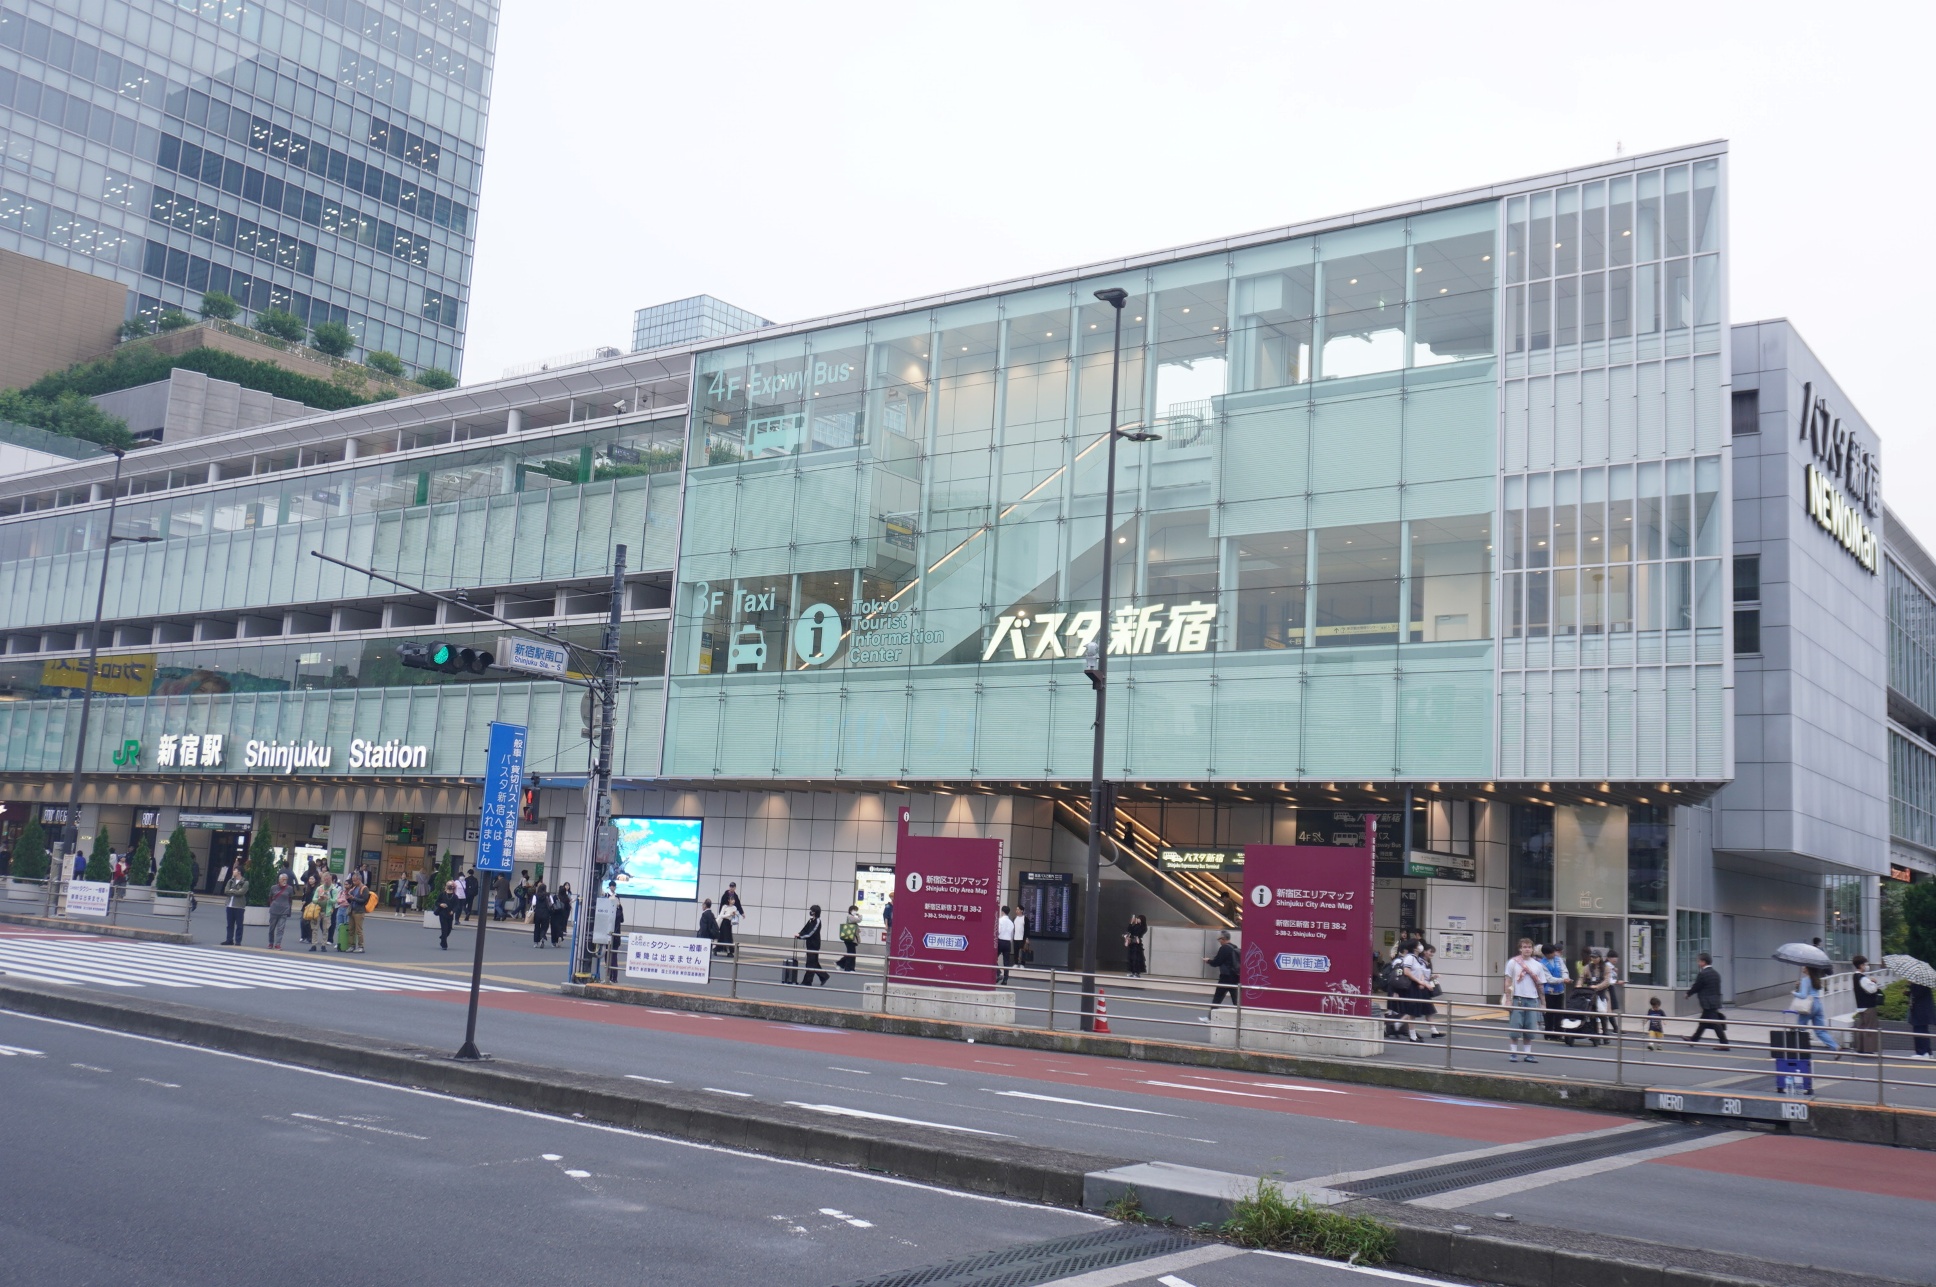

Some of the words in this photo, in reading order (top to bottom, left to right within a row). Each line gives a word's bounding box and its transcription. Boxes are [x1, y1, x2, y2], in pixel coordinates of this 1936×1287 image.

[708, 369, 740, 402] 4F
[750, 370, 808, 399] Expwy
[814, 362, 850, 386] Bus
[1800, 381, 1879, 518] バスタ新宿
[696, 581, 724, 615] 3F
[733, 587, 775, 612] Taxi
[853, 598, 899, 615] Tokyo
[852, 614, 907, 631] Tourist
[982, 600, 1218, 661] バスタ新宿
[851, 628, 944, 647] Information
[514, 643, 564, 664] 新宿駅南口
[514, 656, 538, 666] Shinjuku
[850, 648, 902, 664] Center
[112, 740, 141, 766] JR
[157, 734, 222, 766] 新宿駅
[244, 740, 332, 774] Shinjuku
[350, 738, 427, 768] Station
[494, 754, 512, 840] バスタ新宿へは
[502, 732, 524, 867] 一般車・貸切バス・大型貨物車は
[480, 803, 494, 865] 入れません
[1299, 831, 1311, 841] 4F
[1184, 853, 1225, 862] バスタ新宿
[926, 875, 989, 886] 新宿区エリアマップ
[926, 885, 948, 893] Shinjuku
[949, 886, 960, 894] City
[1276, 888, 1354, 901] 新宿区エリアマップ
[1276, 899, 1303, 908] Shinjuku
[1305, 901, 1318, 909] City
[1595, 898, 1603, 909] C
[1331, 922, 1347, 930] 38-2
[928, 936, 963, 947] 甲州街道
[635, 952, 702, 965] 乗降は出来ません
[1281, 957, 1325, 969] 甲州街道
[1659, 1094, 1683, 1110] NERO
[1782, 1103, 1808, 1120] NERO
